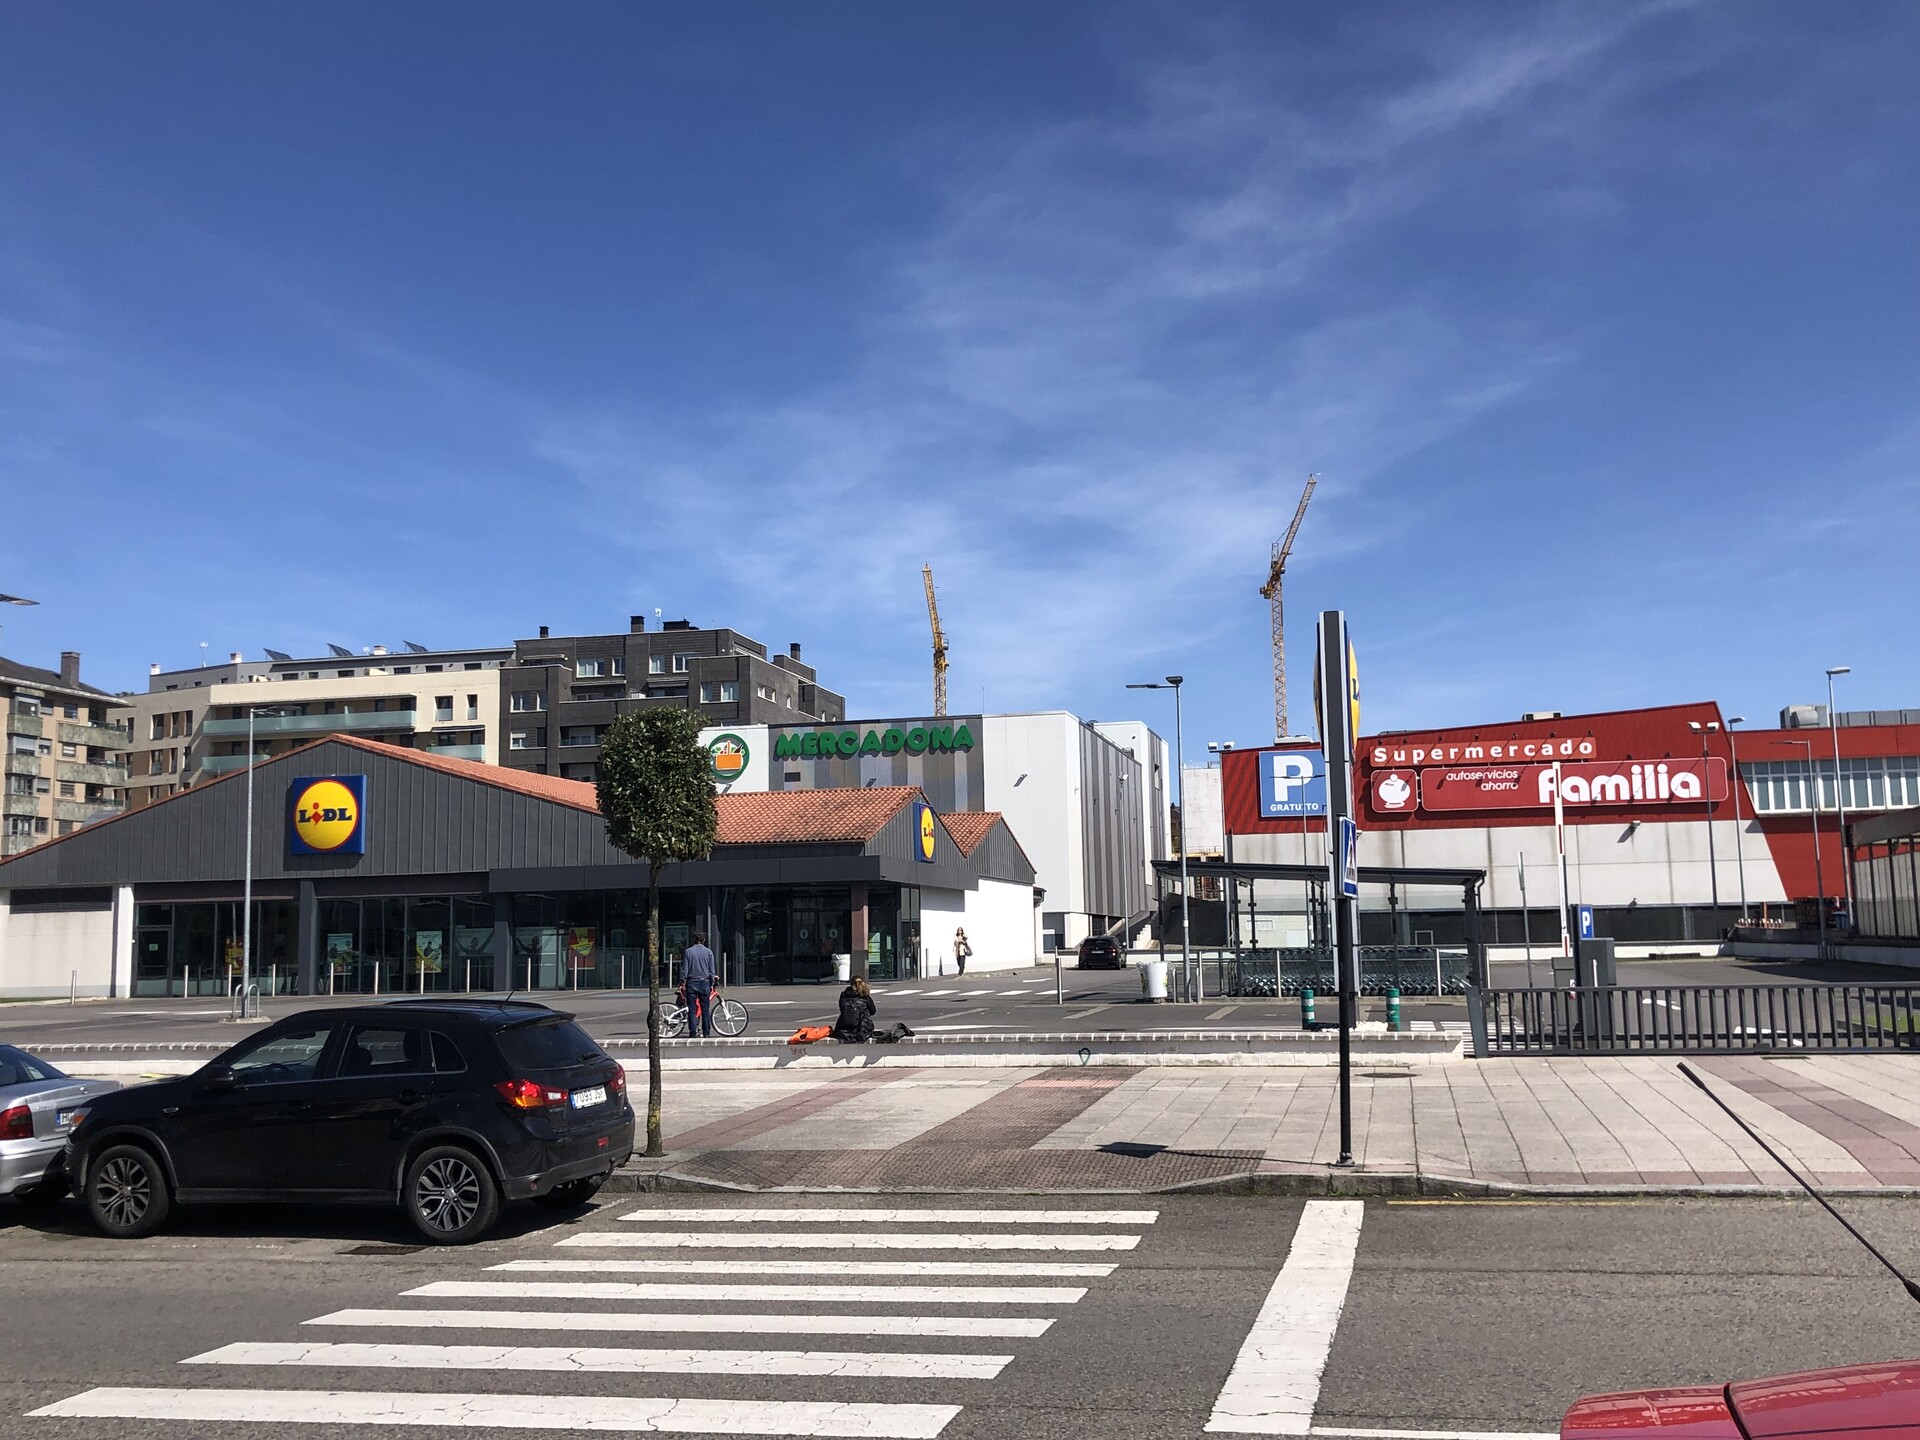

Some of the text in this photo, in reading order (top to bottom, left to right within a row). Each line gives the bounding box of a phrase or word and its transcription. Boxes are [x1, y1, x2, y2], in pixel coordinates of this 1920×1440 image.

[776, 725, 975, 756] MERCADONA
[1374, 739, 1593, 765] Supermercado
[1273, 755, 1313, 802] P
[1446, 769, 1518, 782] autoservicios
[1481, 780, 1518, 791] ahorro
[1582, 911, 1590, 935] P
